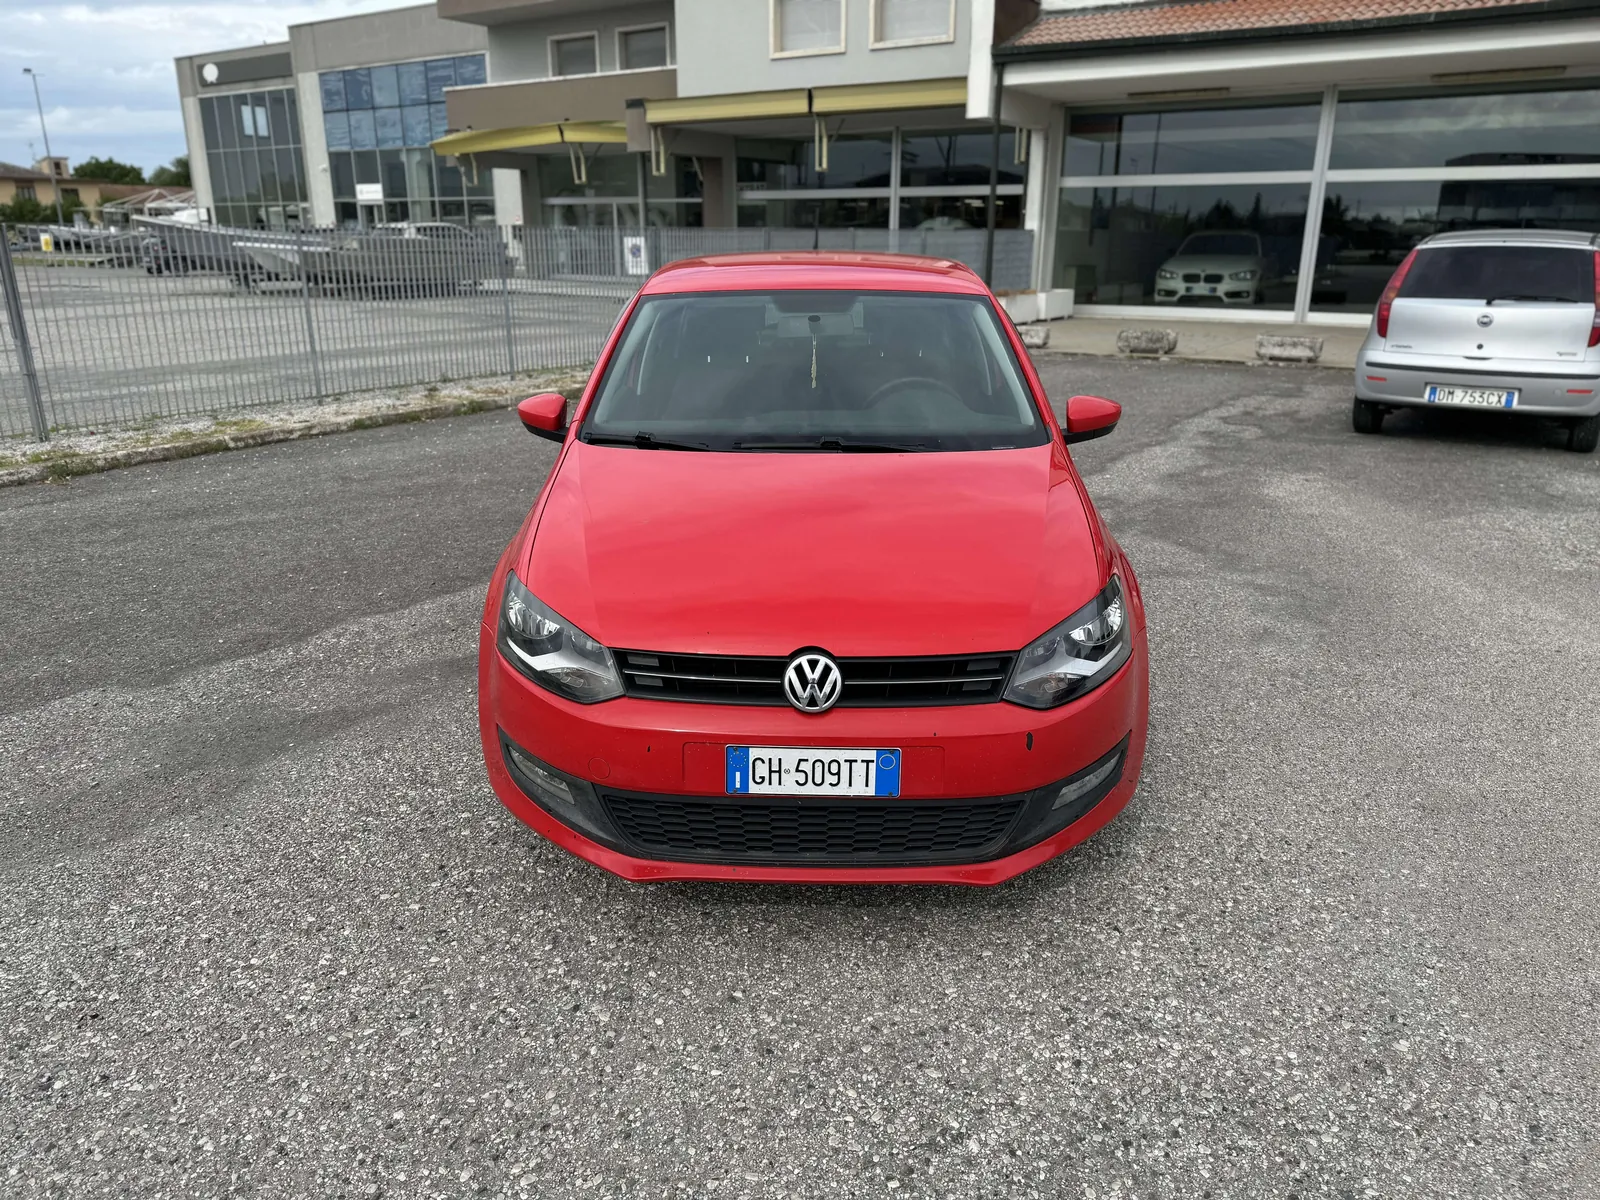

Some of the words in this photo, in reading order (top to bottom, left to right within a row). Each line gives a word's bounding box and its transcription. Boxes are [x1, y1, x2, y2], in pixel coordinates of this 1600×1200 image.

[1437, 388, 1455, 402] DM
[1459, 390, 1505, 407] 753CX
[784, 654, 842, 713] VW
[735, 771, 741, 789] I
[751, 757, 782, 786] GH
[795, 758, 875, 788] 509TT
